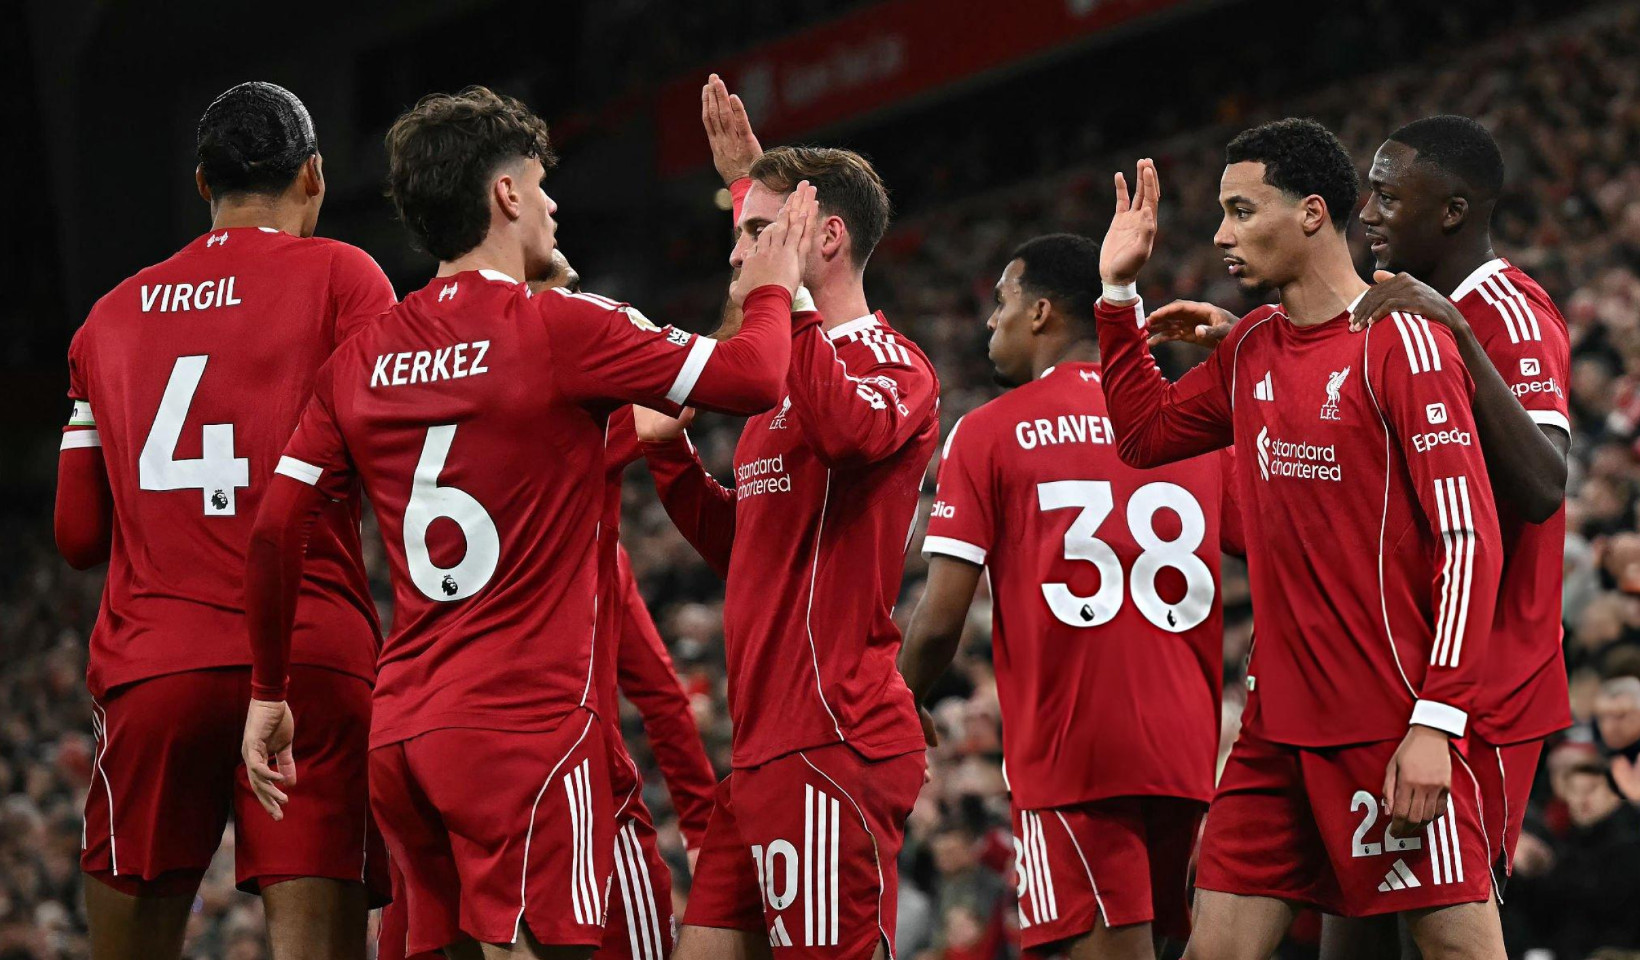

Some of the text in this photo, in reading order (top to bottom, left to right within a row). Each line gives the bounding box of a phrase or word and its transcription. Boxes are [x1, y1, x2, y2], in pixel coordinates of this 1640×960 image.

[140, 276, 242, 313] VIRGIL
[370, 339, 491, 388] KERKEZ
[139, 354, 249, 516] 4
[1015, 414, 1116, 450] GRAVEN
[1271, 438, 1336, 463] standard
[738, 453, 784, 481] standard
[1270, 456, 1342, 482] chartered
[737, 473, 791, 501] chartered
[402, 424, 500, 602] 6
[1036, 480, 1215, 633] 38
[751, 838, 799, 912] 10
